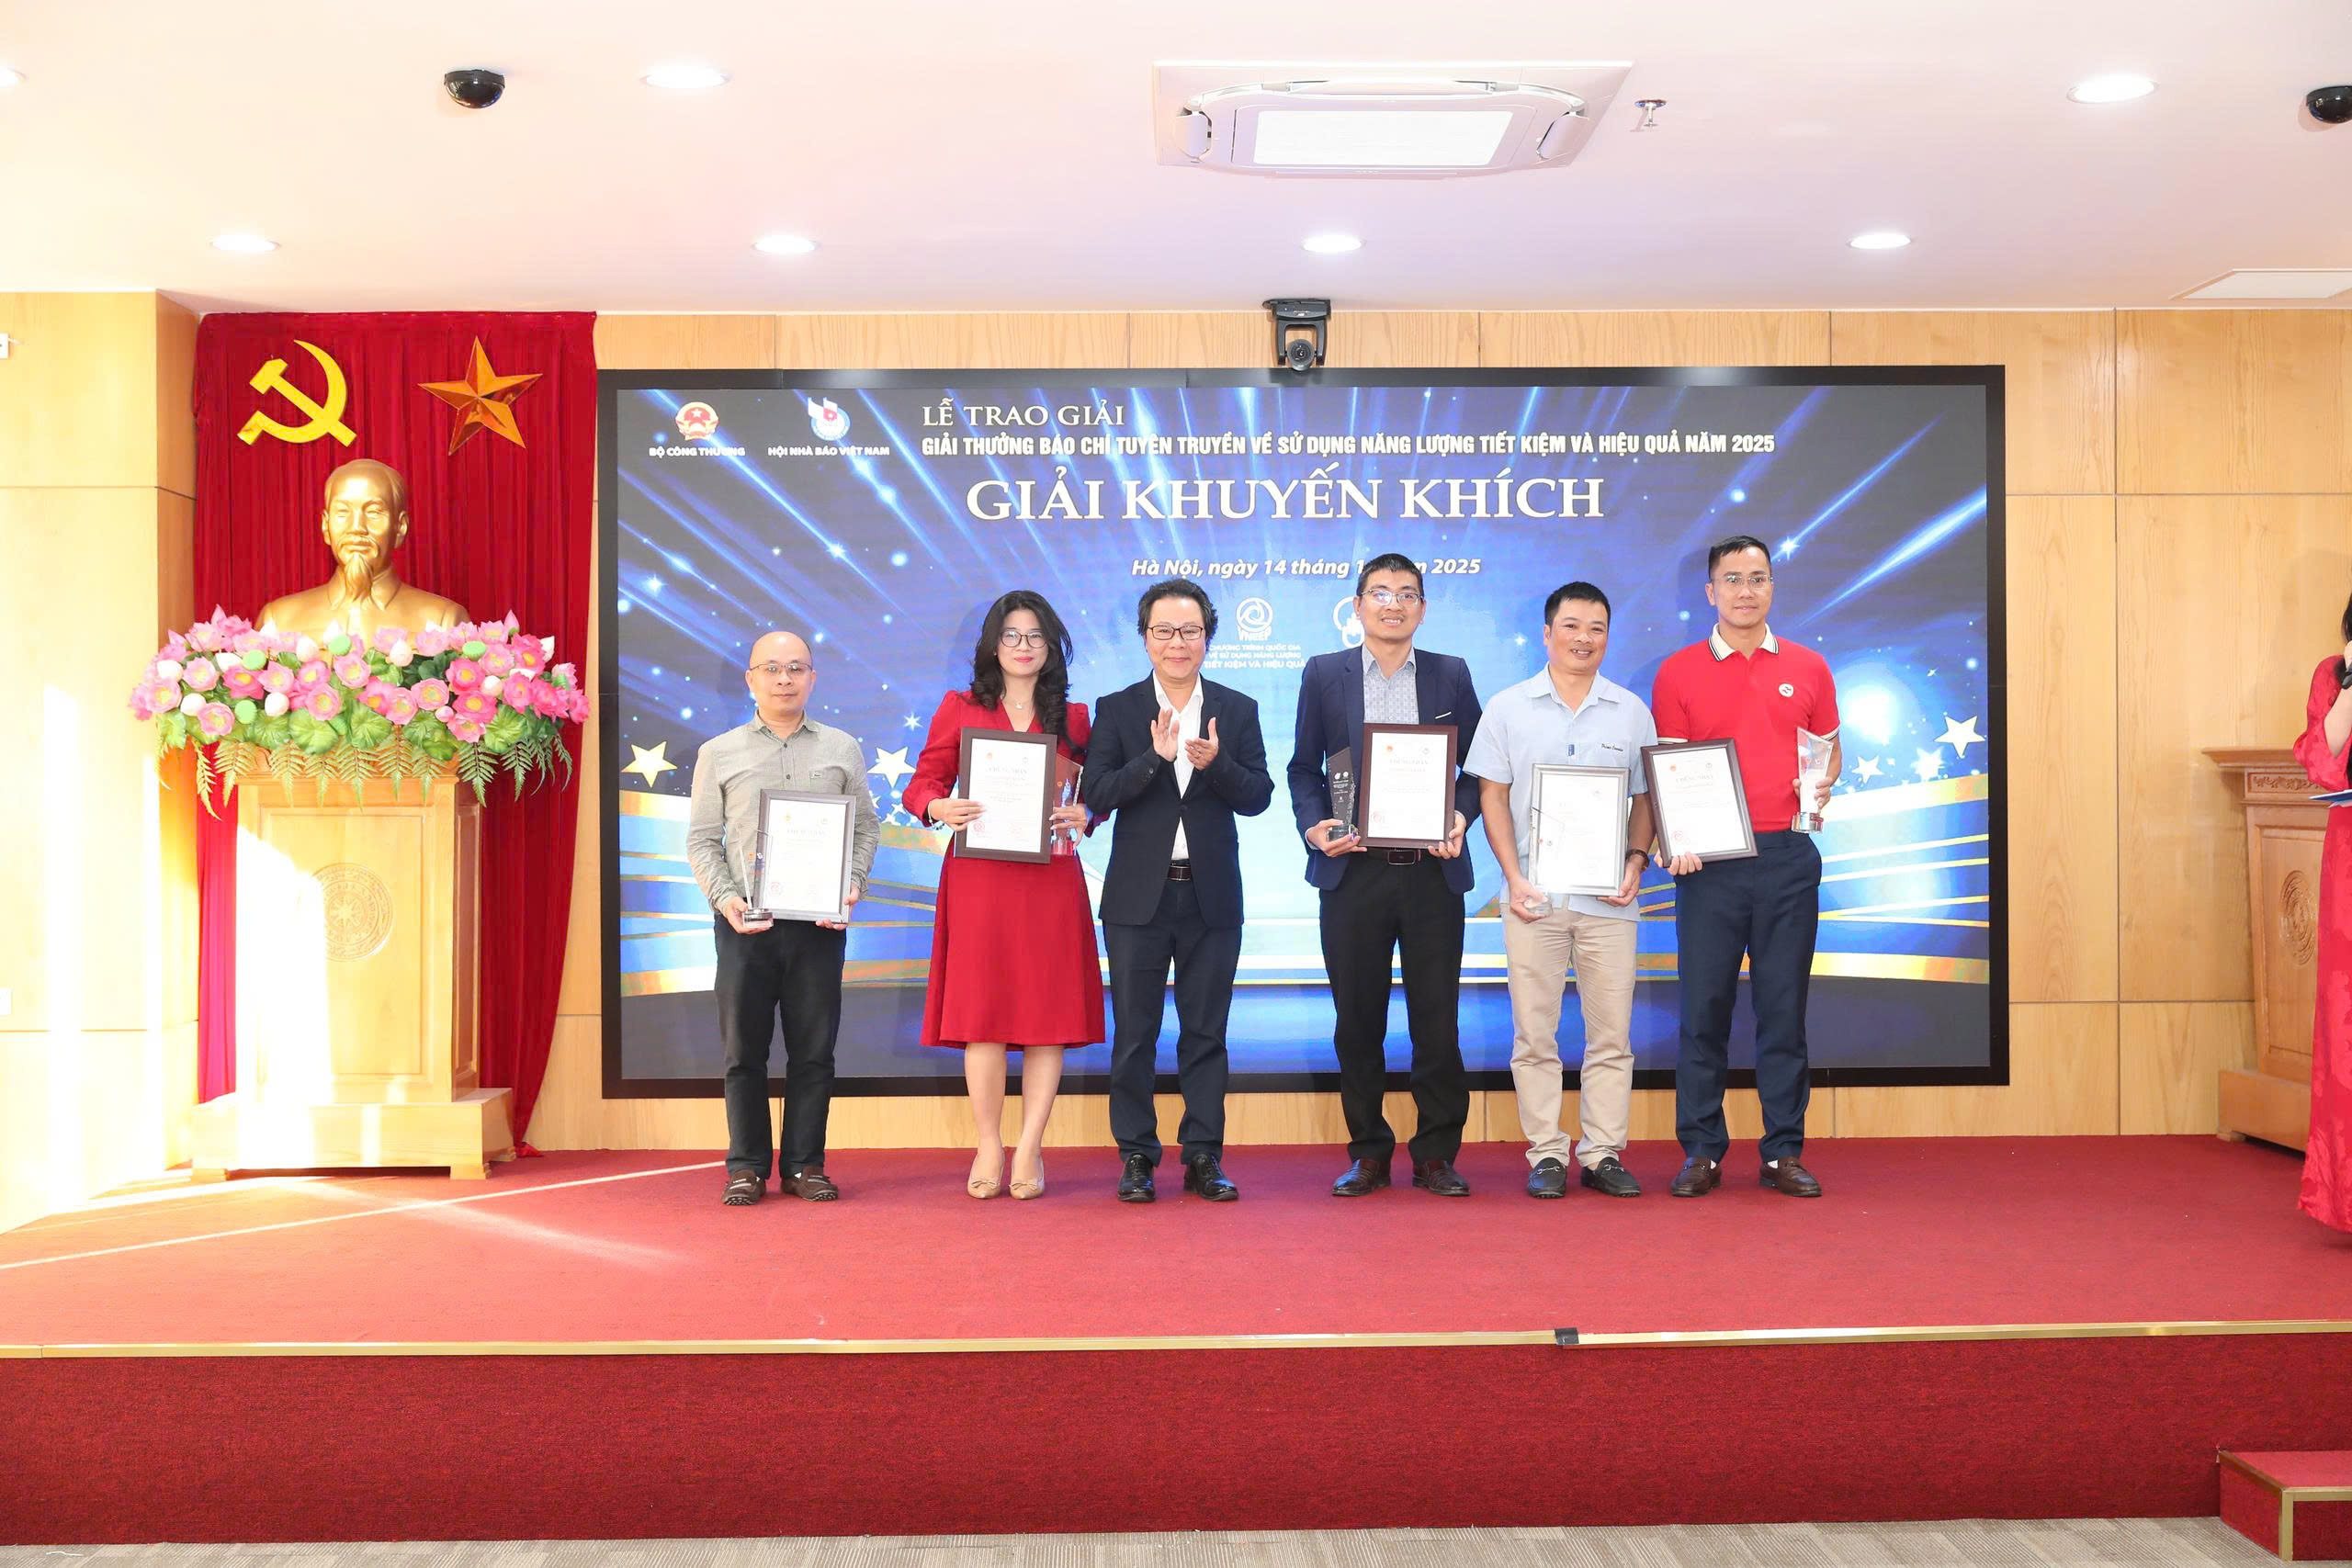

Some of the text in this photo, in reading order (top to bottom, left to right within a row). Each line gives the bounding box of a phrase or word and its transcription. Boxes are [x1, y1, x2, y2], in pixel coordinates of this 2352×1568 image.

[922, 397, 1125, 426] LỄ TRAO GIẢI
[649, 446, 665, 458] BỘ
[666, 446, 697, 457] CÔNG
[768, 445, 788, 458] HỘI
[789, 445, 813, 456] NHÀ
[815, 445, 839, 456] BÁO
[864, 447, 889, 456] NAM
[922, 429, 1775, 457] GIẢI THƯỞNG BÁO CHÍ TUYÊN TRUYỀN VỀ SỬ DỤNG NĂNG LƯỢNG TIẾT KIỆM VÀ HIỆU QUẢ NĂM 2025
[966, 461, 1604, 520] GIẢI KHUYẾN KHÍCH
[1132, 559, 1159, 575] Hà
[1164, 558, 1204, 579] Nội,
[1208, 559, 1258, 579] ngày
[1264, 559, 1286, 575] 14
[1291, 558, 1351, 579] tháng
[1430, 558, 1481, 574] 2025
